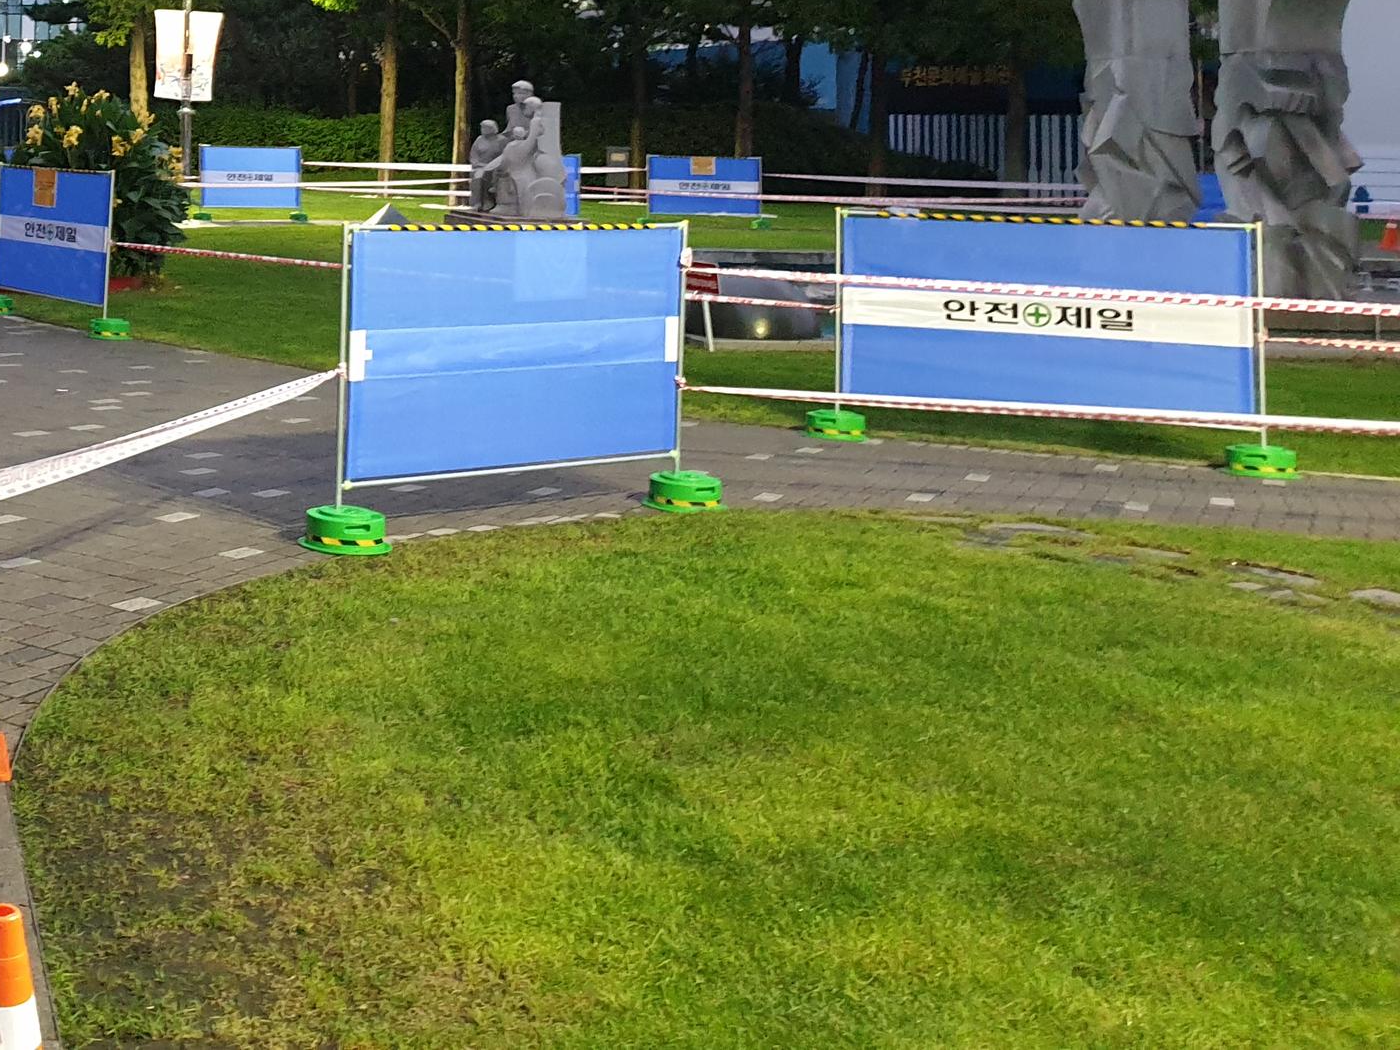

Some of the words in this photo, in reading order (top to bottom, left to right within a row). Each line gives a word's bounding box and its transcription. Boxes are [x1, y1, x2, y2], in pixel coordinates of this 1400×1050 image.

[25, 222, 46, 239] 안전
[55, 226, 77, 243] 제일
[943, 299, 1019, 325] 안전
[1055, 305, 1134, 332] 제일
